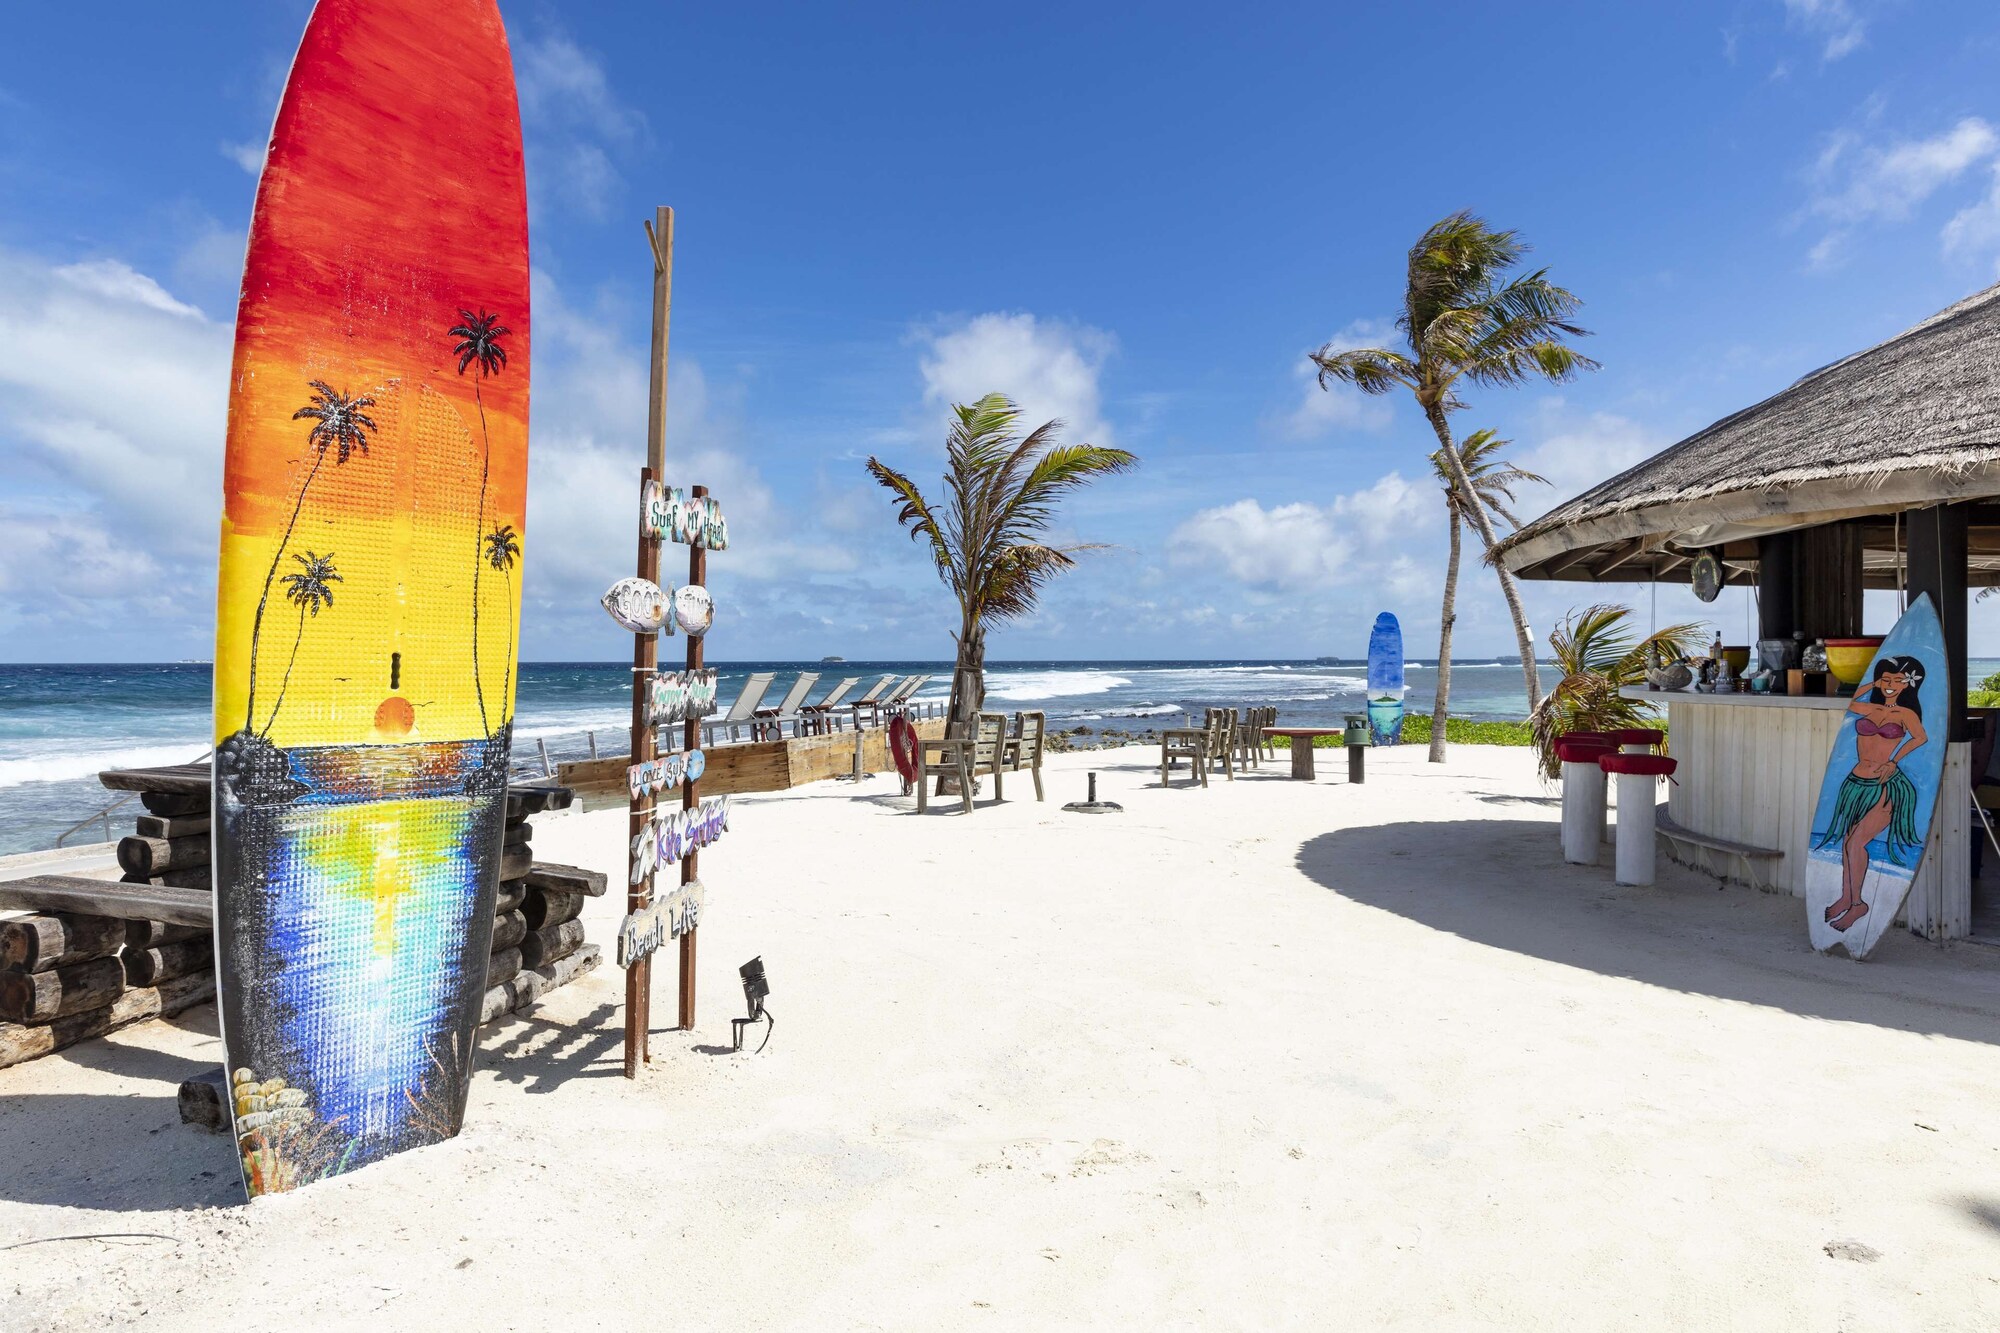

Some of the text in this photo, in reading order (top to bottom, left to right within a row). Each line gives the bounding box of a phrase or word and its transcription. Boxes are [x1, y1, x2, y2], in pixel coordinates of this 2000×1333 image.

[652, 501, 724, 541] SURF MY HEART
[654, 686, 683, 704] ENJOY
[632, 767, 663, 788] LOVE
[656, 809, 724, 872] Kite Surfing
[627, 897, 699, 960] Beach Life
